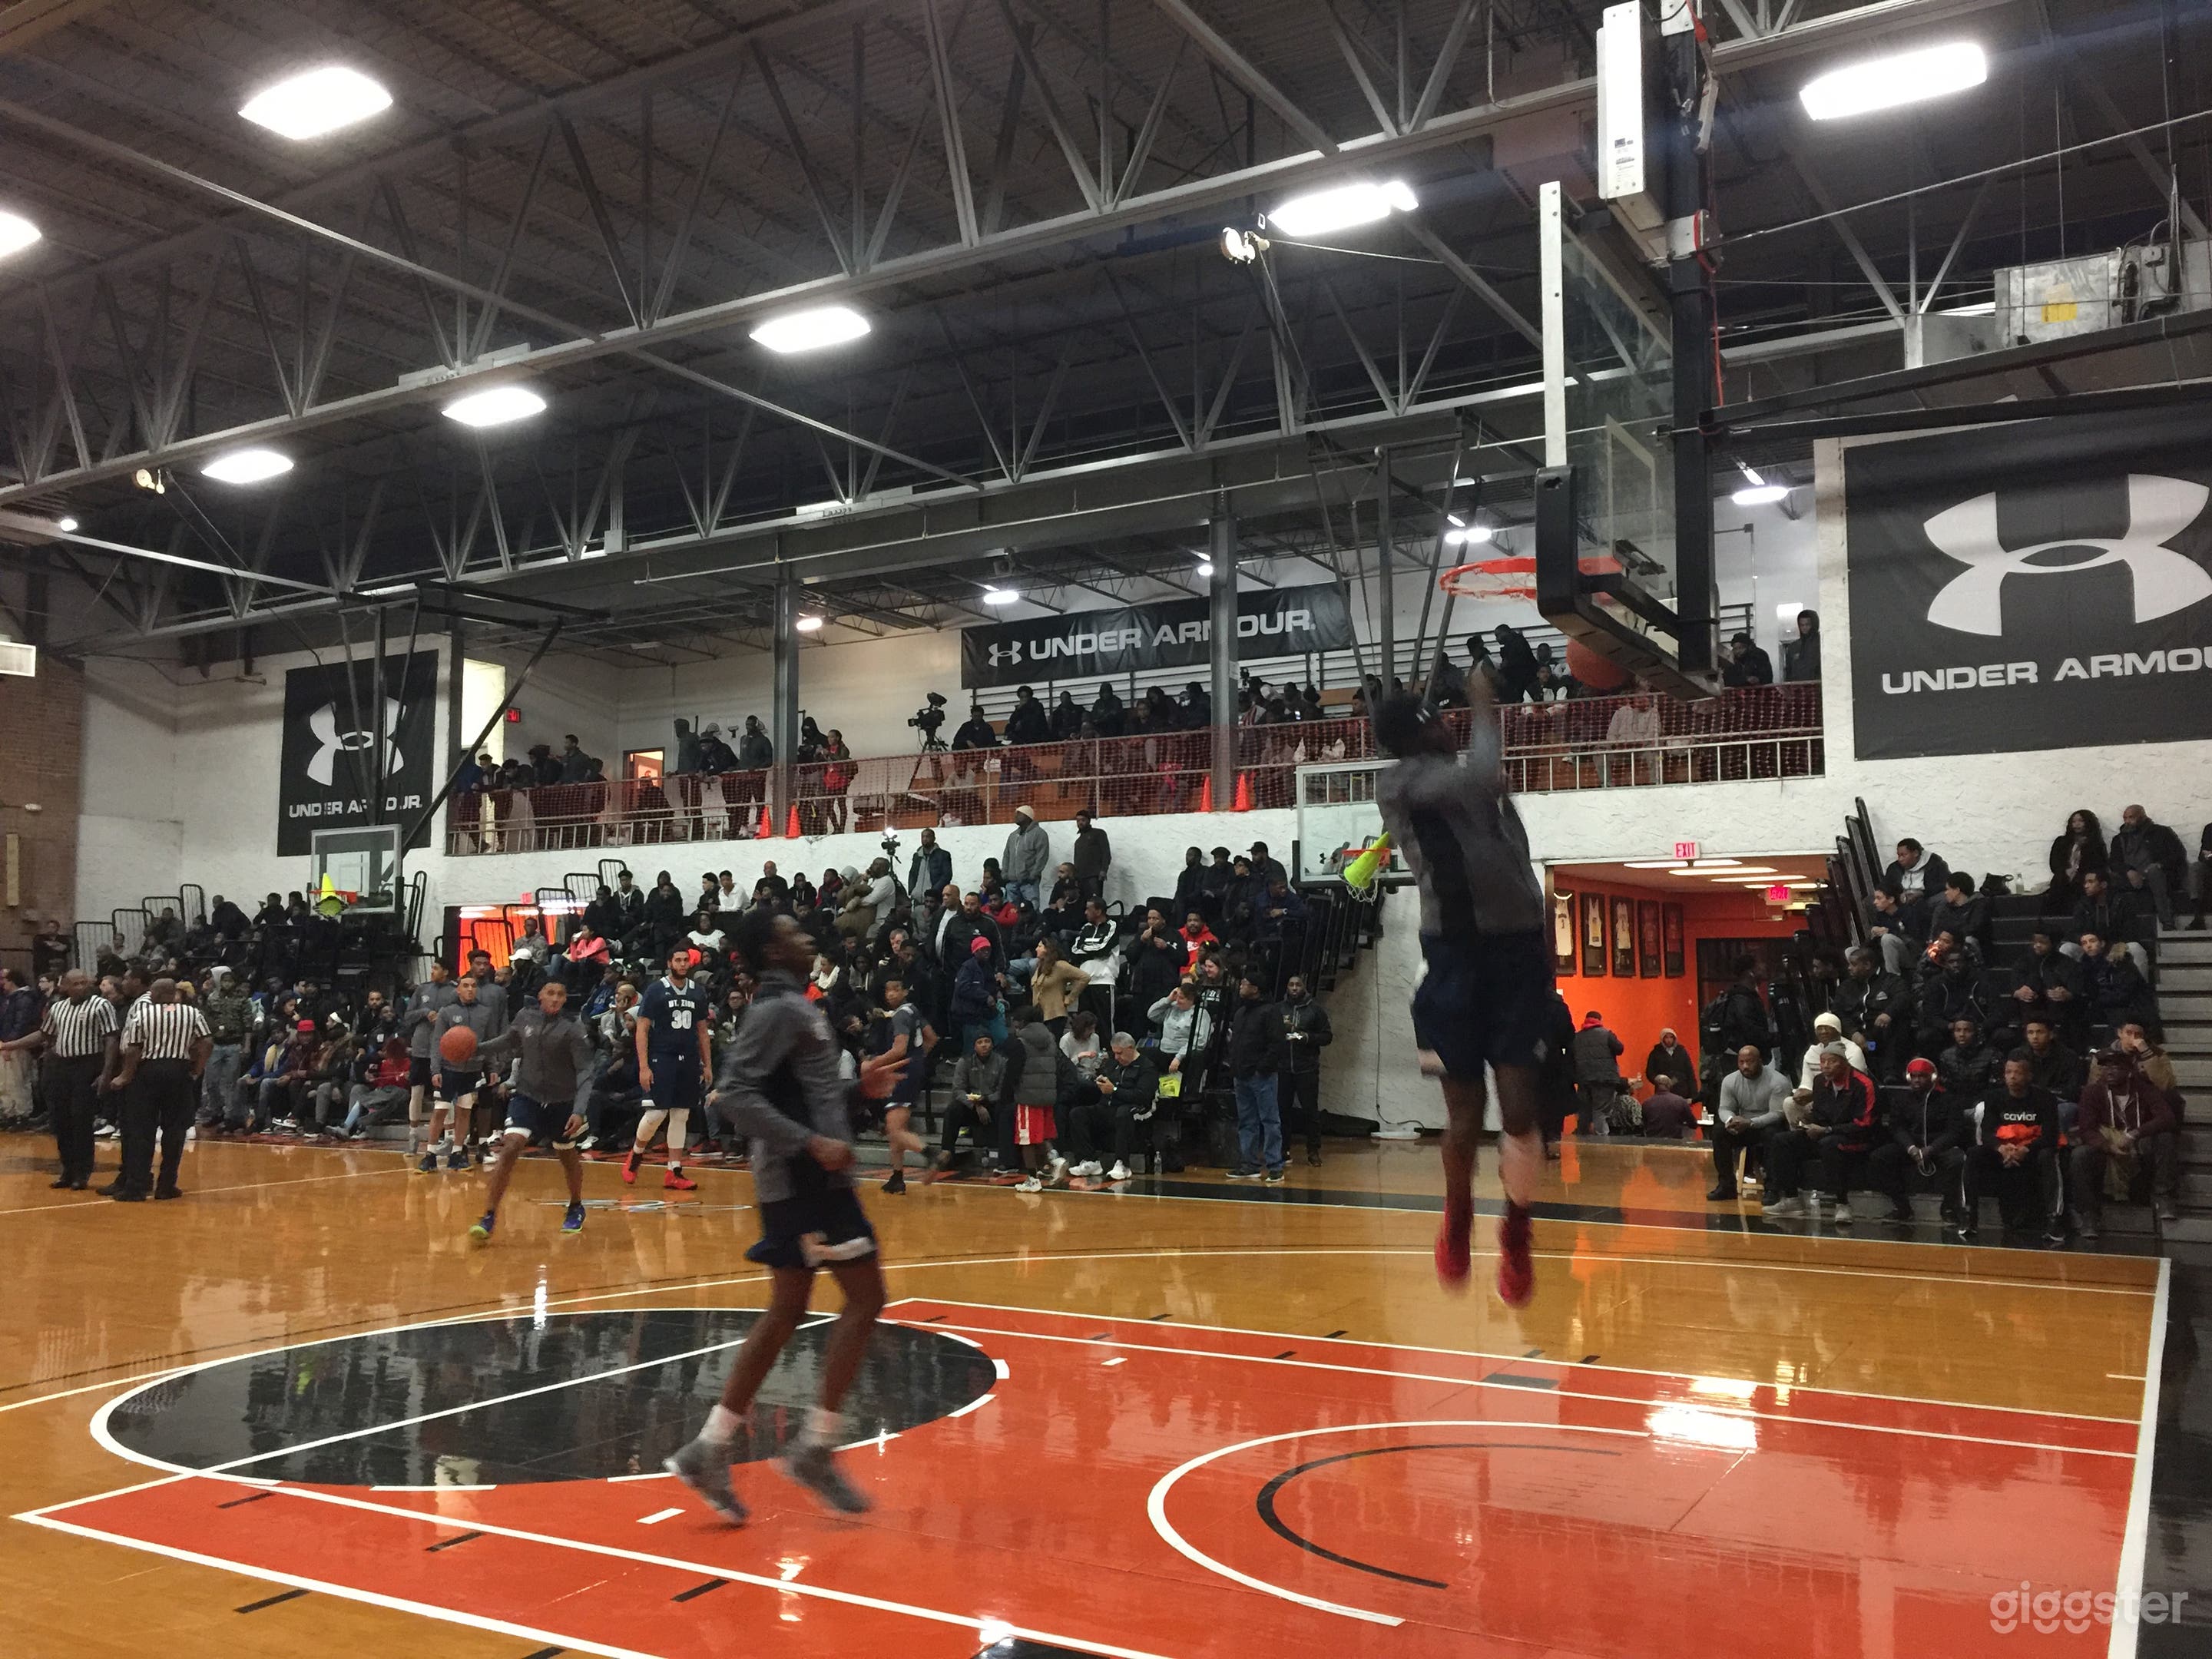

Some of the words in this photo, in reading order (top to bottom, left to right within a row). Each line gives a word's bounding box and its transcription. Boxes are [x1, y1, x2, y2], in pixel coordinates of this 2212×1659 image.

[1030, 628, 1142, 661] UNDER
[1882, 661, 2038, 694] UNDER
[2053, 645, 2212, 682] ARMO
[289, 800, 343, 818] UNDER
[1676, 842, 1696, 858] EXIT
[680, 999, 695, 1009] ZION
[671, 1009, 692, 1030] 30
[2003, 1111, 2037, 1121] caviar
